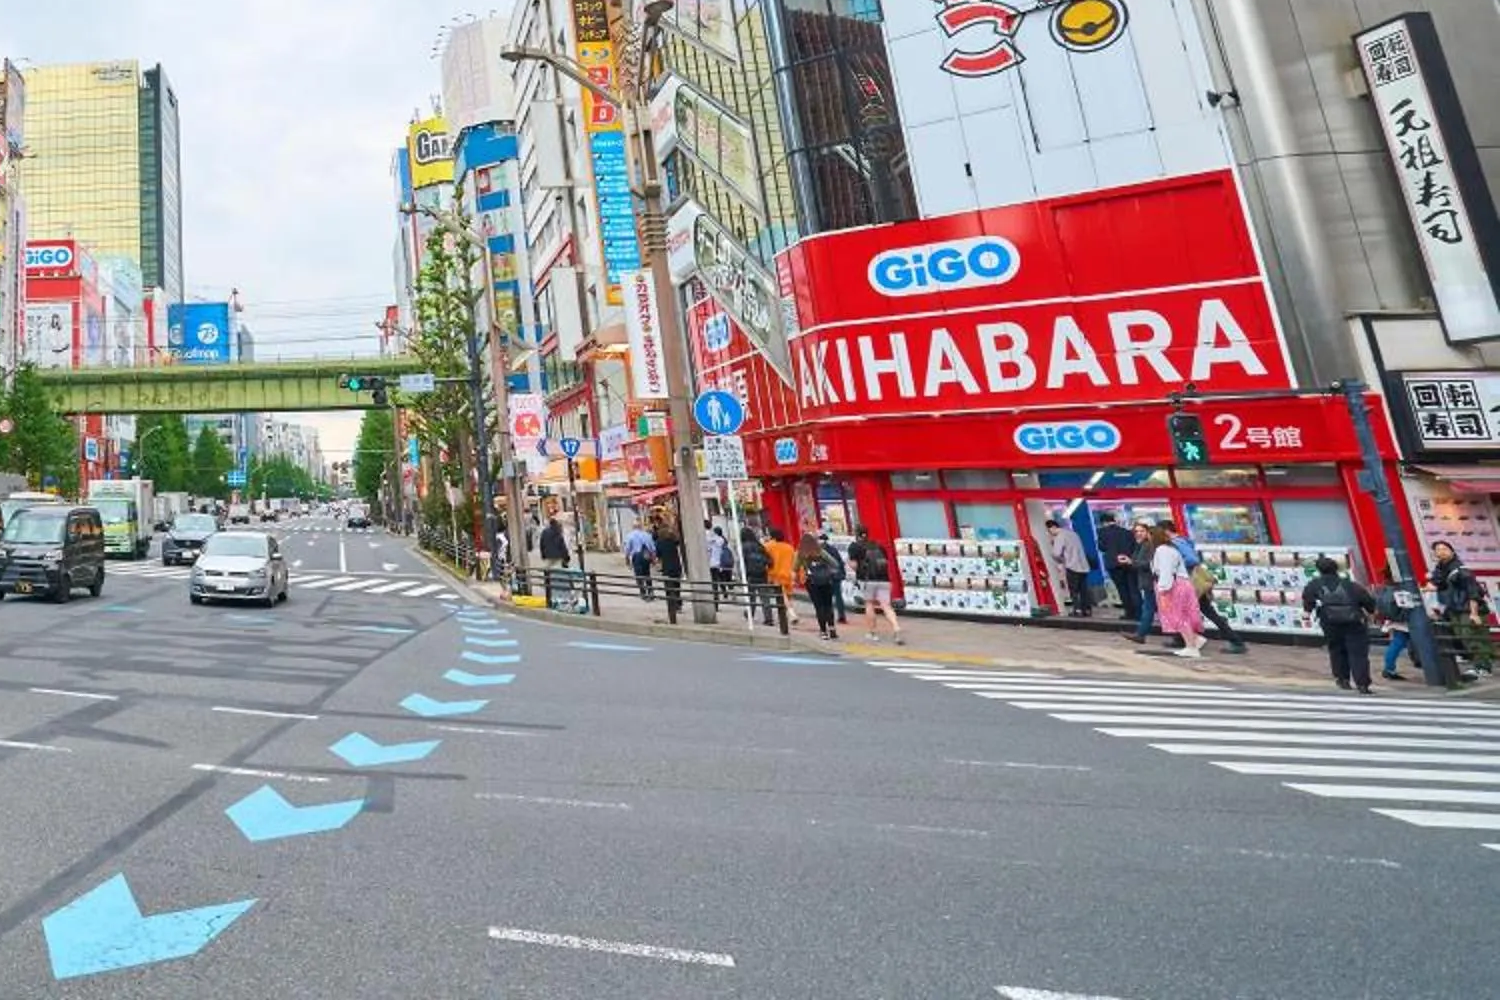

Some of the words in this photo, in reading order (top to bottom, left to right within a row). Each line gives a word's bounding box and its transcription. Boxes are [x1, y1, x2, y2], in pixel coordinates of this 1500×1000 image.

[1389, 98, 1463, 245] 元祖寿司
[874, 242, 1012, 288] GiGO
[801, 299, 1268, 408] AKIHABARA
[1412, 382, 1478, 408] 回転
[1019, 424, 1116, 452] GiGO
[1214, 413, 1302, 451] 2号館
[1424, 412, 1486, 438] 寿司
[564, 439, 578, 454] 17
